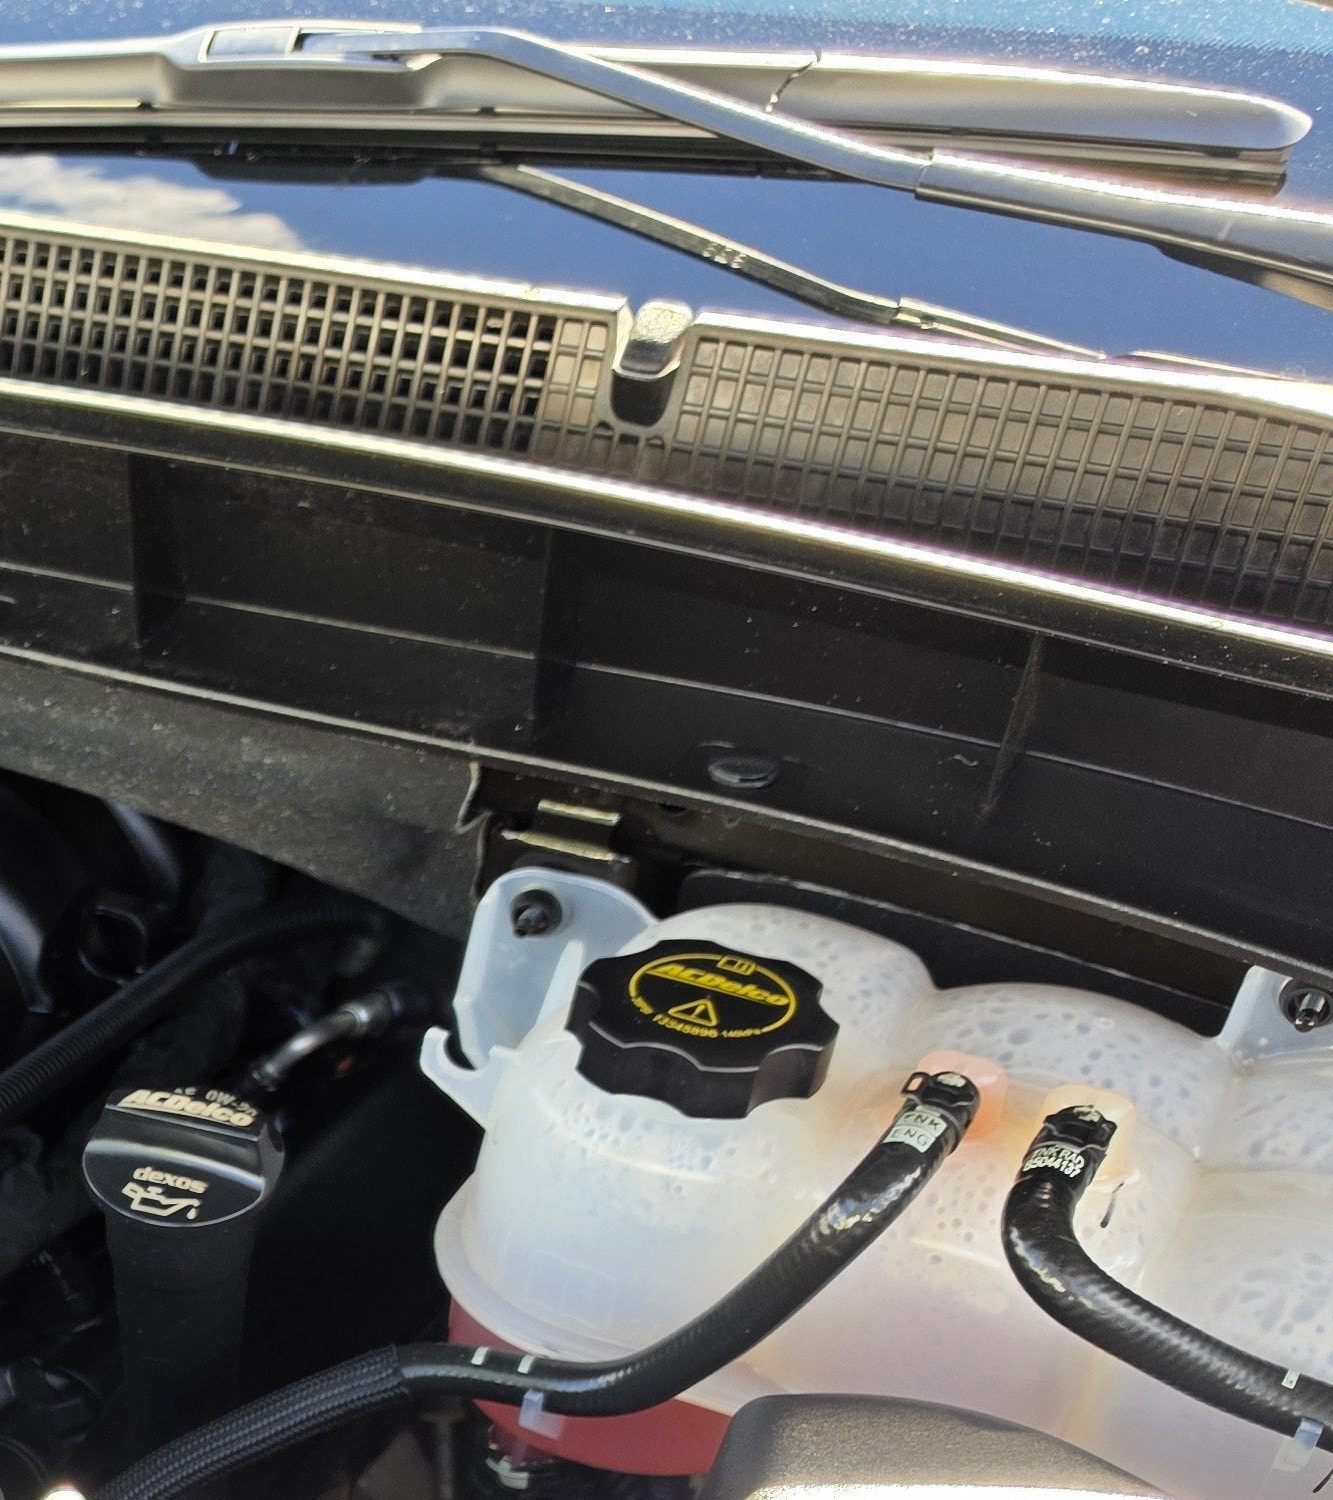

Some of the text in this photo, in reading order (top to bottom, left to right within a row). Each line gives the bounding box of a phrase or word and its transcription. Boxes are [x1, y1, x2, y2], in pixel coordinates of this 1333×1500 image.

[117, 1088, 255, 1127] ACDelco
[891, 1129, 928, 1147] ENG
[133, 1166, 210, 1194] dexos
